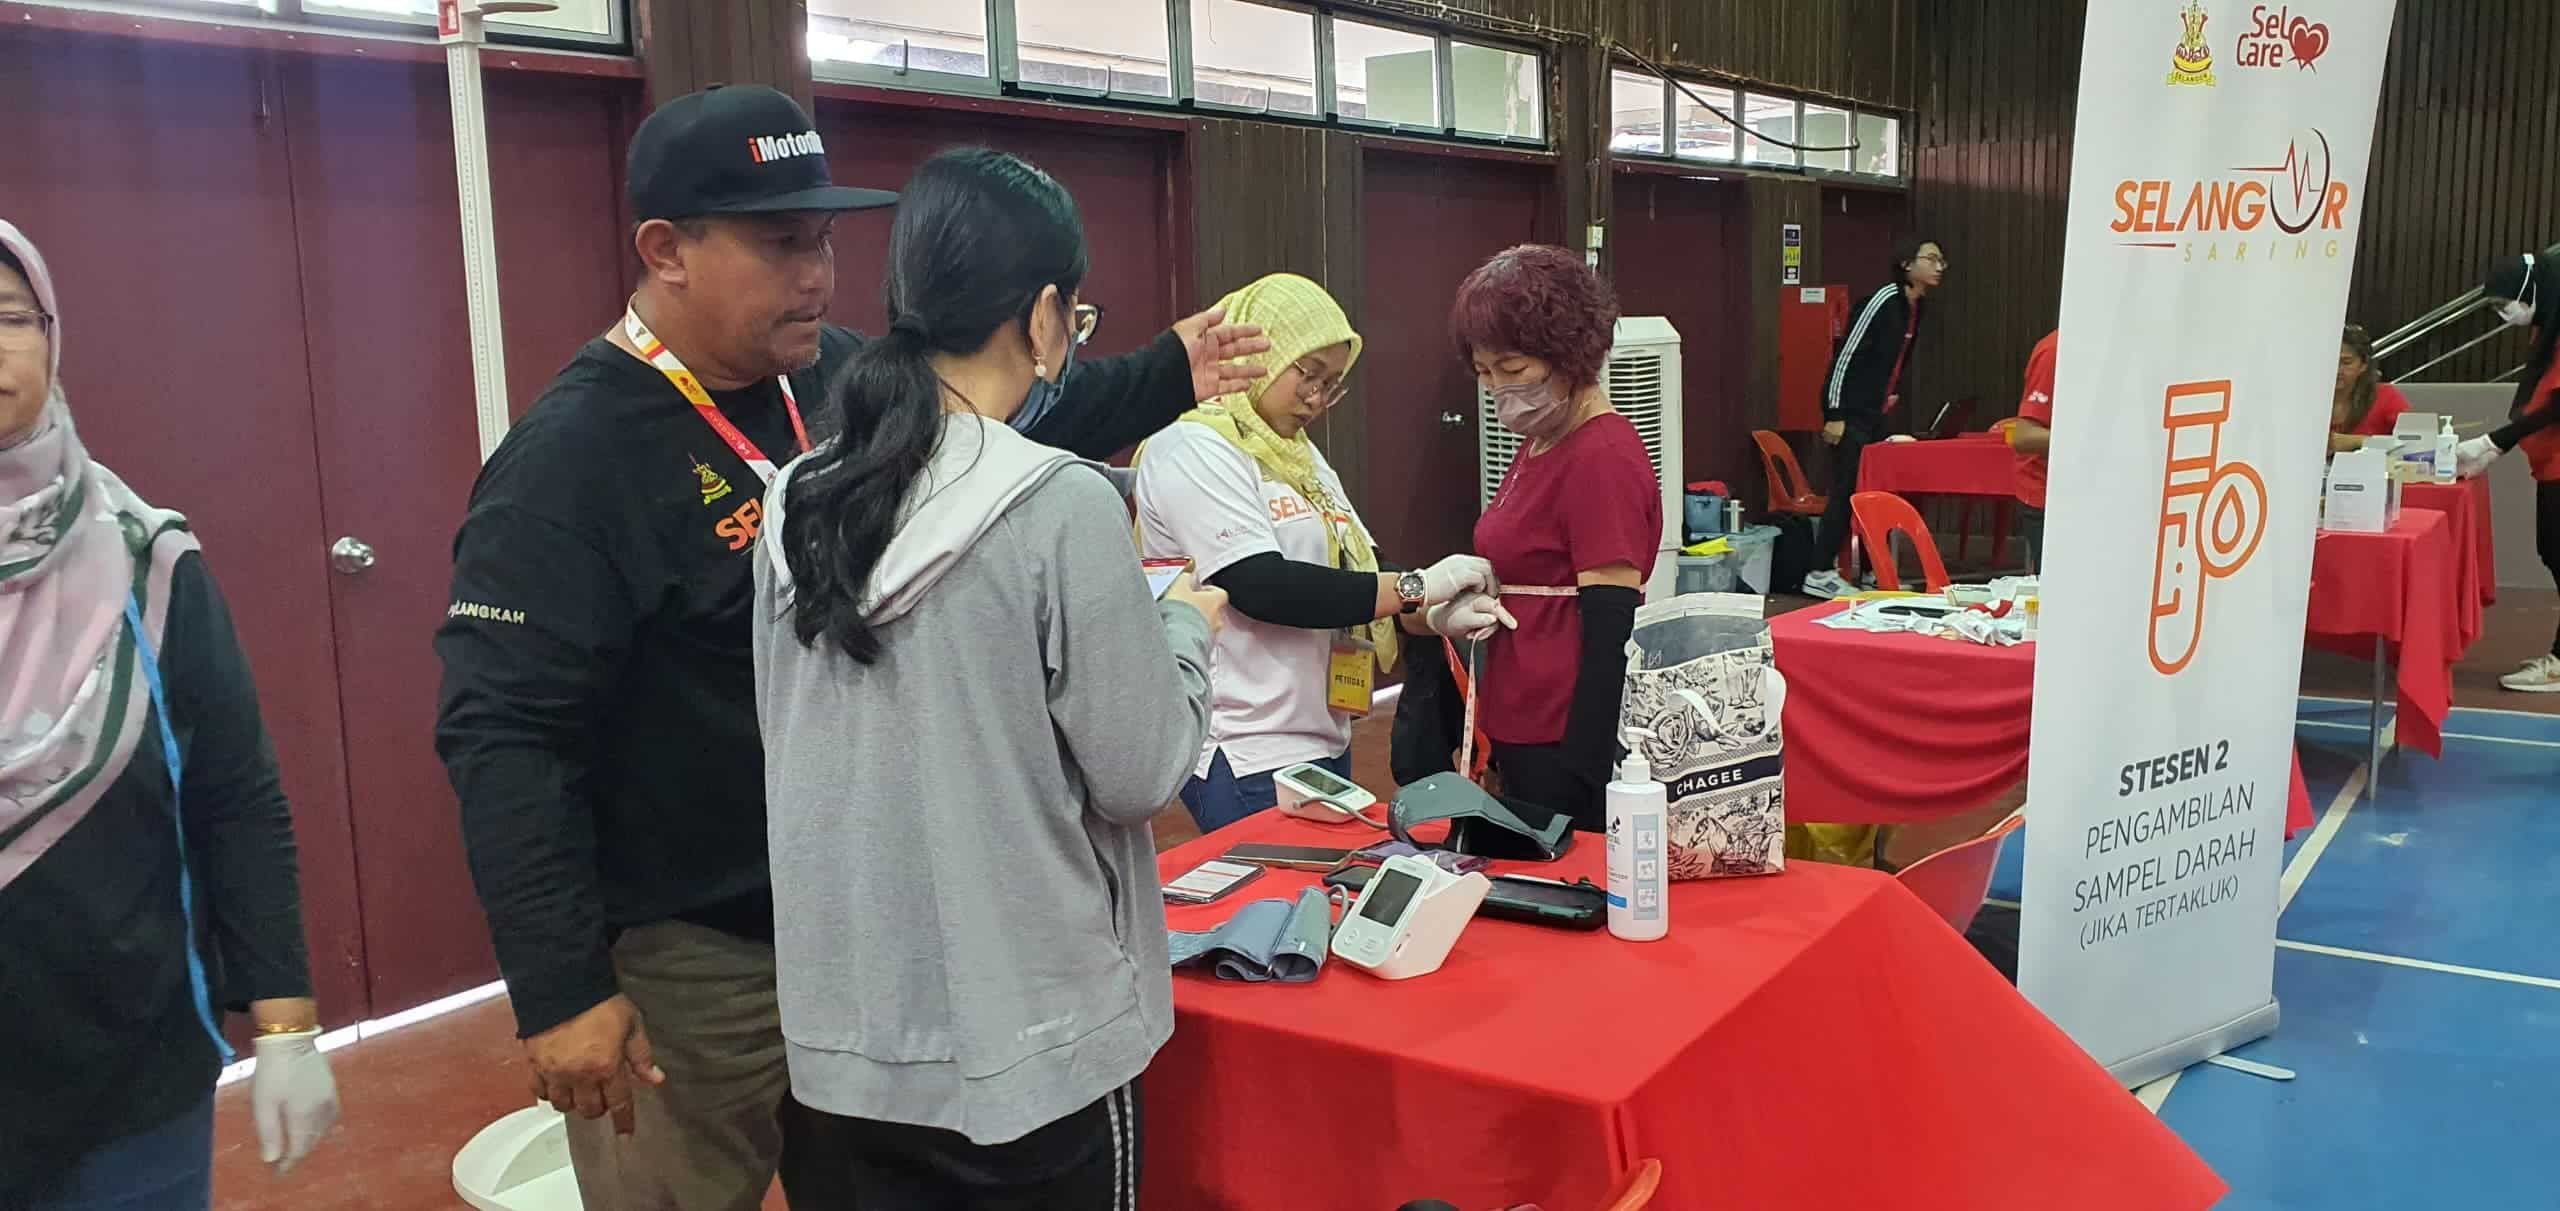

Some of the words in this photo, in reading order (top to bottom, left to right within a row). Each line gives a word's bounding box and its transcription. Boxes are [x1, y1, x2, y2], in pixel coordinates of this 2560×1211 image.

[2236, 33, 2283, 67] Care
[2251, 5, 2289, 39] Sel
[2110, 128, 2349, 234] SELANGOR
[2184, 239, 2338, 263] SARING
[1676, 768, 1743, 796] CHAGEE
[2118, 743, 2210, 797] STESEN
[2214, 739, 2230, 771] 2
[2085, 781, 2255, 860] PENGAMBILAN
[2073, 856, 2167, 913] SAMPEL
[2174, 828, 2256, 881] DARAH
[2080, 911, 2128, 951] (JIKA
[2135, 874, 2239, 929] TERTAKLUK)
